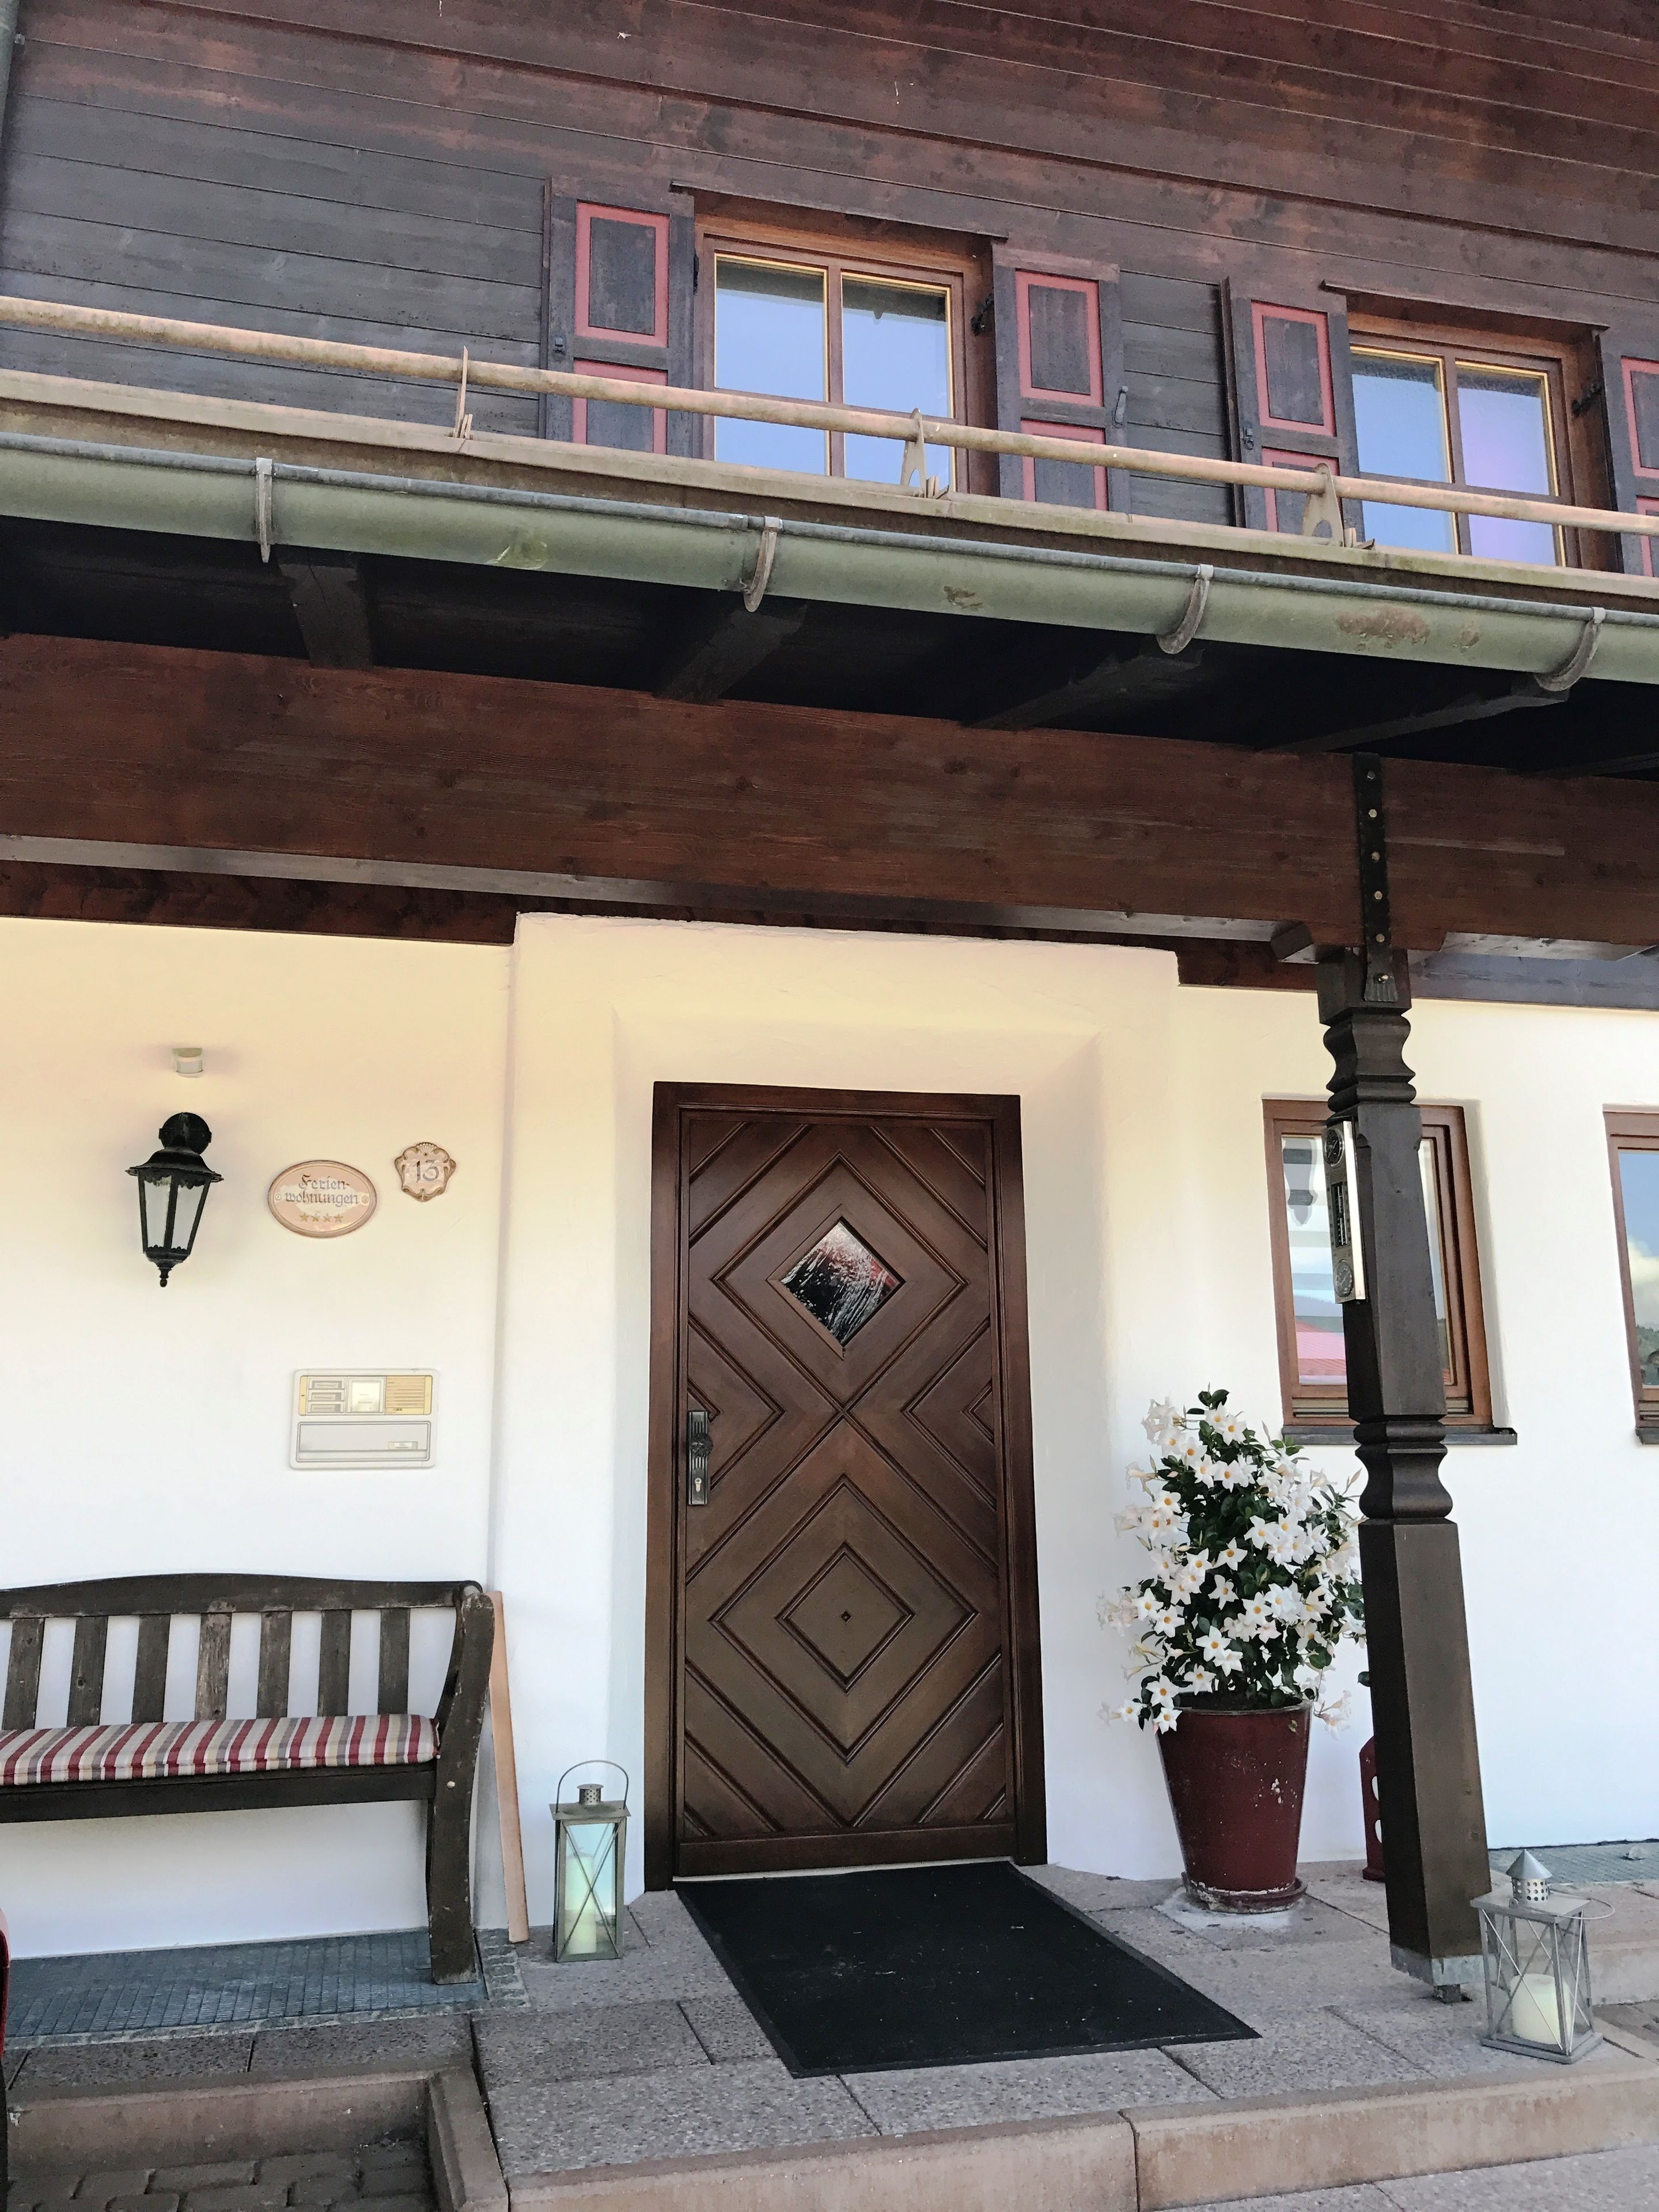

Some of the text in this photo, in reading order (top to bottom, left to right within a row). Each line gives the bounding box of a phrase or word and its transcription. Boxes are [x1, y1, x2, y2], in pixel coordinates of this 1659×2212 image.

[413, 1159, 440, 1183] 13
[298, 1173, 350, 1190] Ferien-
[285, 1188, 359, 1207] wohnungen
